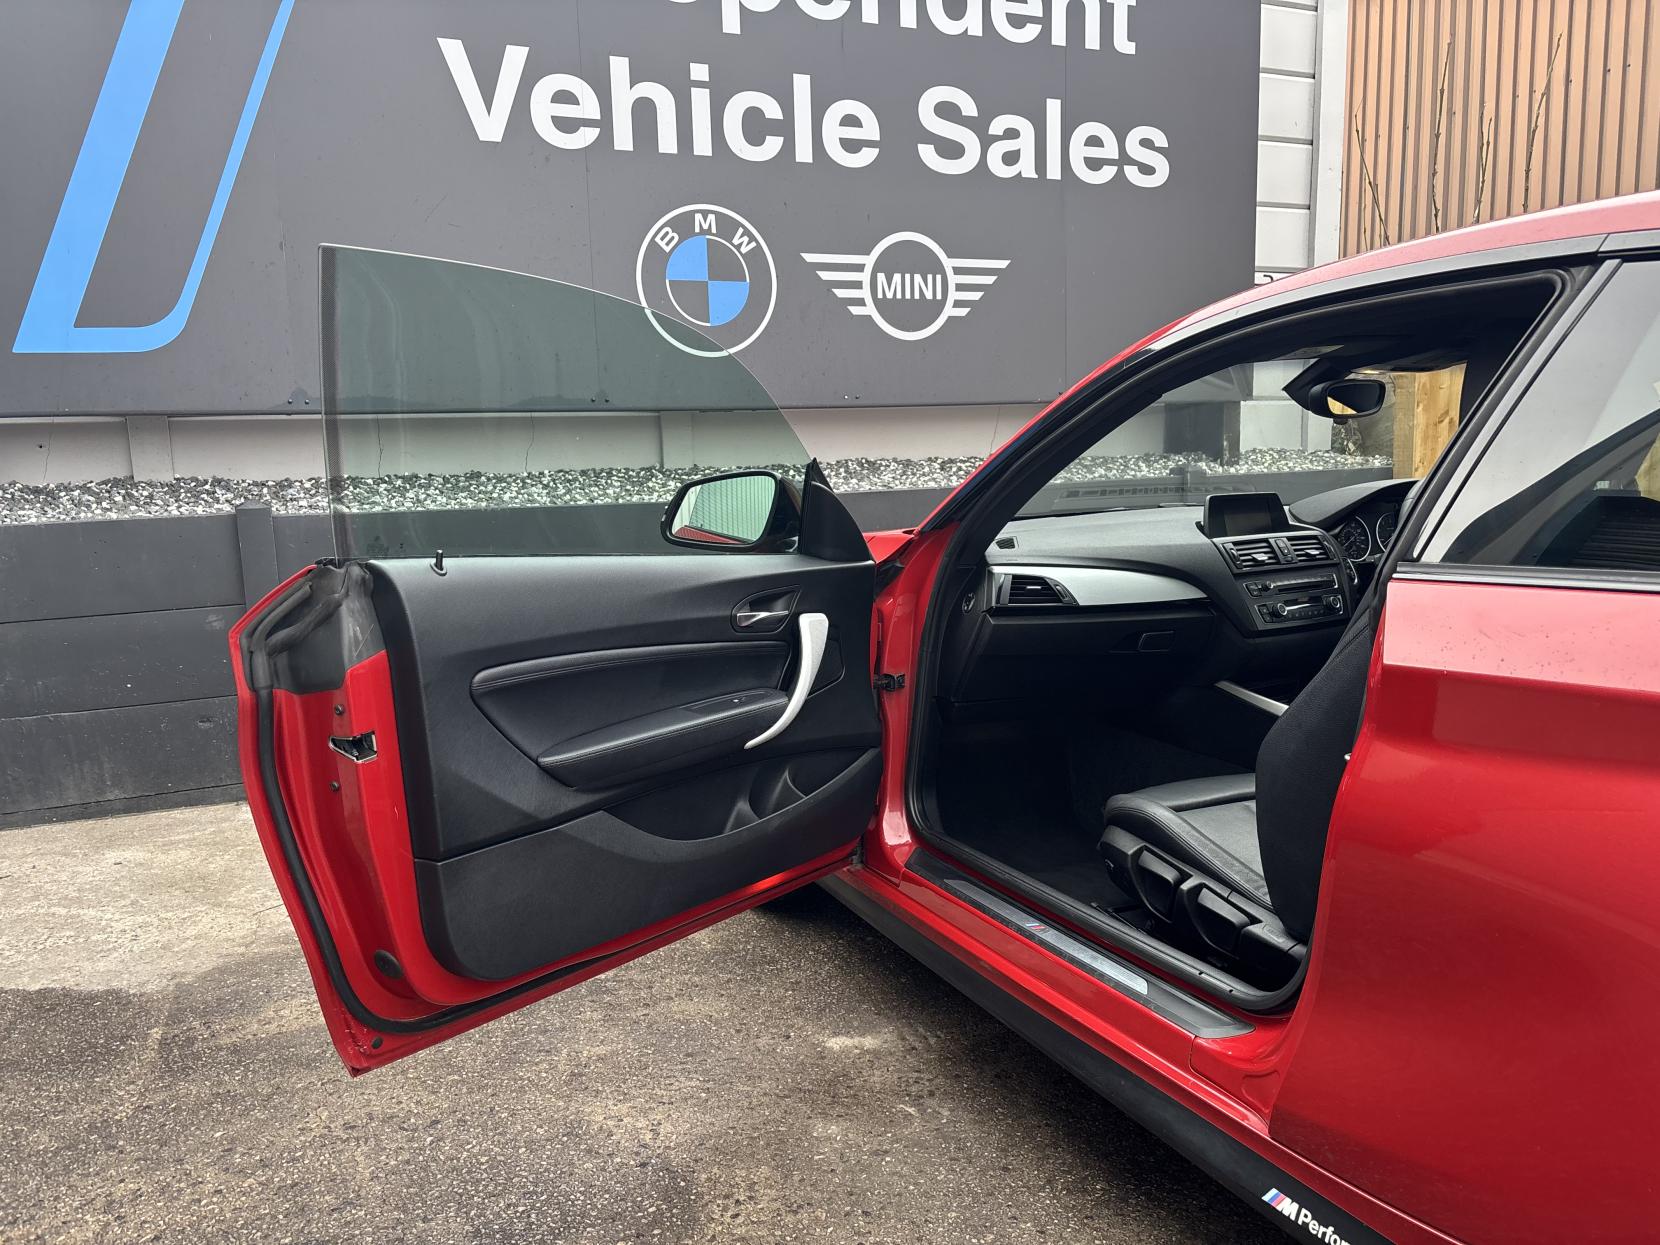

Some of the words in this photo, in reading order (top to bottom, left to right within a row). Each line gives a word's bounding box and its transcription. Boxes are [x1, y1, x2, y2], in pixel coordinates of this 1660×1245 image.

[437, 37, 881, 169] Vehicle
[917, 85, 1170, 188] Sales
[654, 212, 757, 255] BMW
[876, 272, 942, 300] MINI
